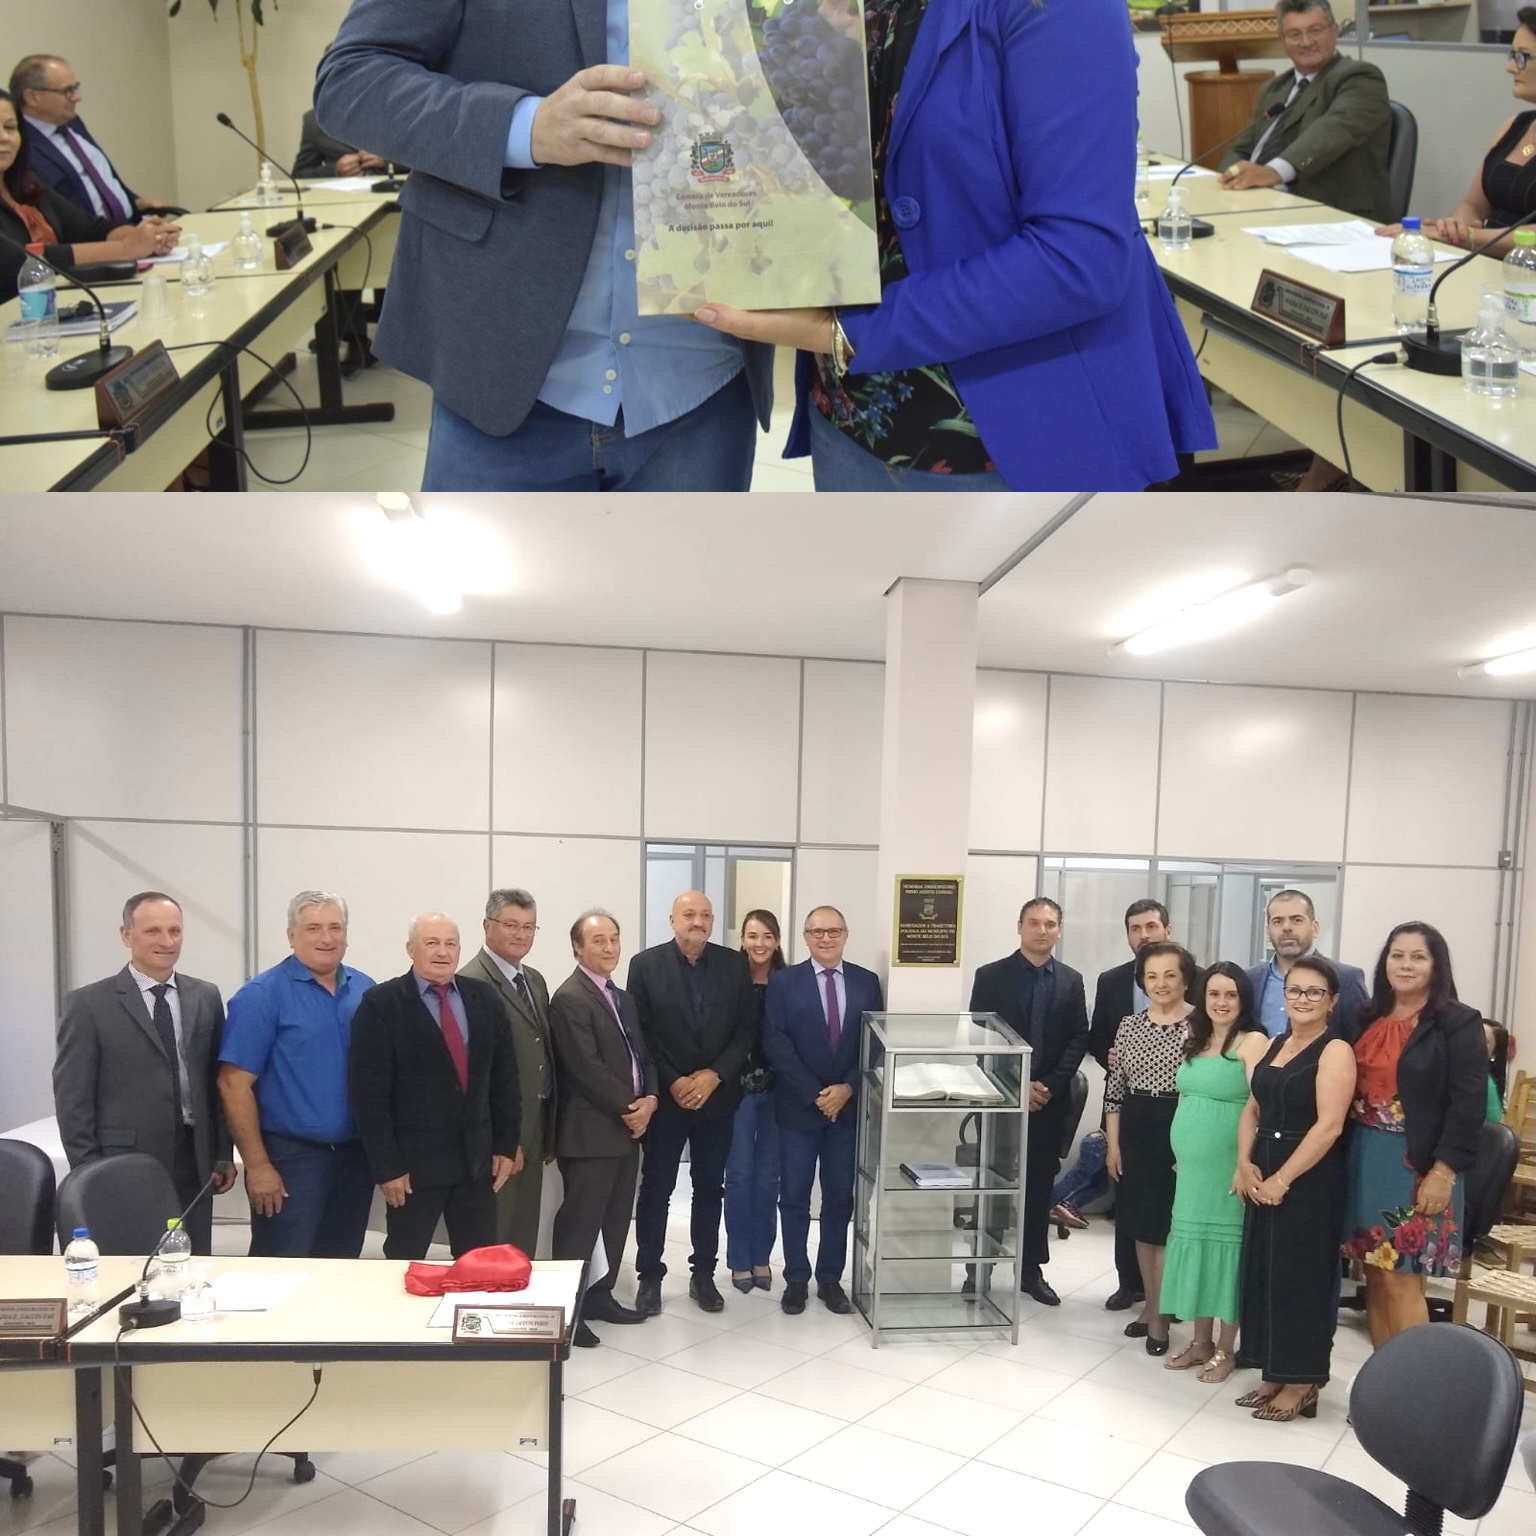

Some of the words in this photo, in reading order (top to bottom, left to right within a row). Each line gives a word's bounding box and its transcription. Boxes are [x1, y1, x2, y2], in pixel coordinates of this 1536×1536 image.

[704, 191, 714, 199] de
[715, 190, 757, 198] Vereadores
[668, 224, 674, 232] A
[676, 223, 708, 232] decisão
[709, 223, 734, 231] passa
[735, 222, 750, 230] por
[751, 219, 774, 228] aqui!
